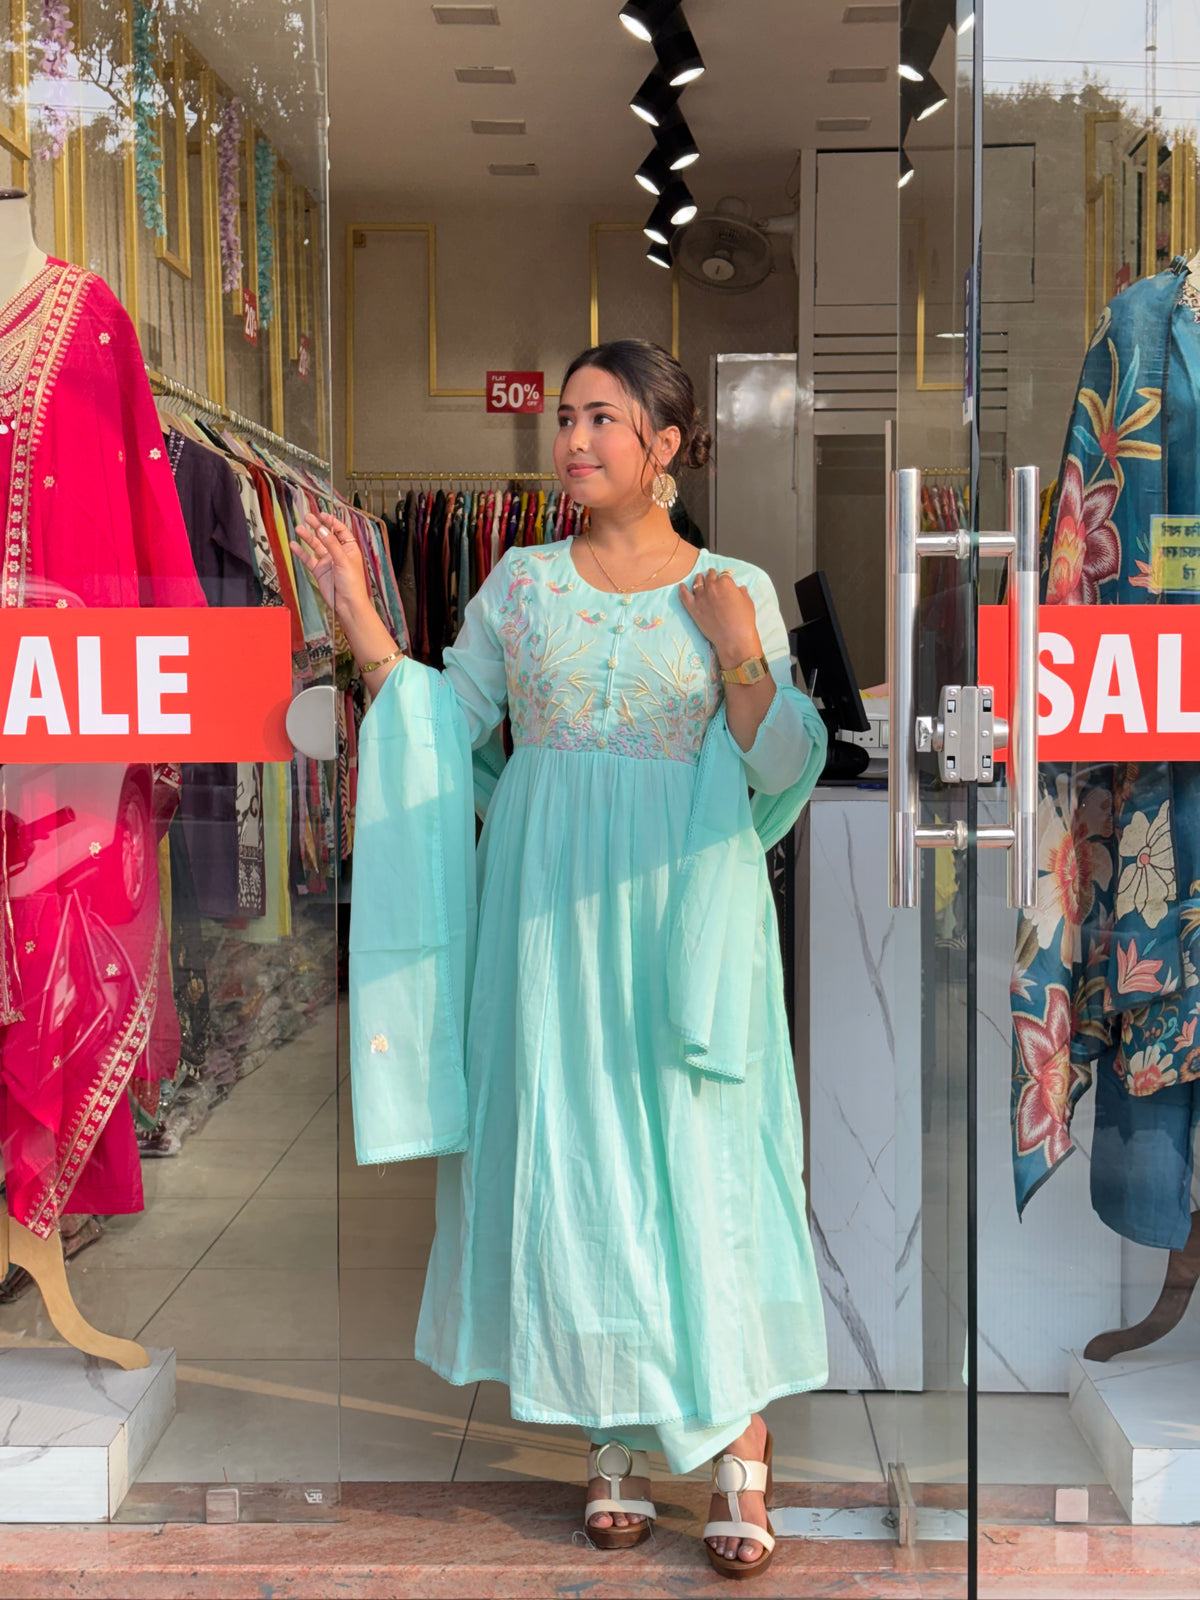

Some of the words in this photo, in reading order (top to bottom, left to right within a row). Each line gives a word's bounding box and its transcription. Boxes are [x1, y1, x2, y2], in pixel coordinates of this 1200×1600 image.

[491, 383, 540, 408] 50%
[3, 636, 191, 735] ALE
[1038, 632, 1200, 735] SAL
